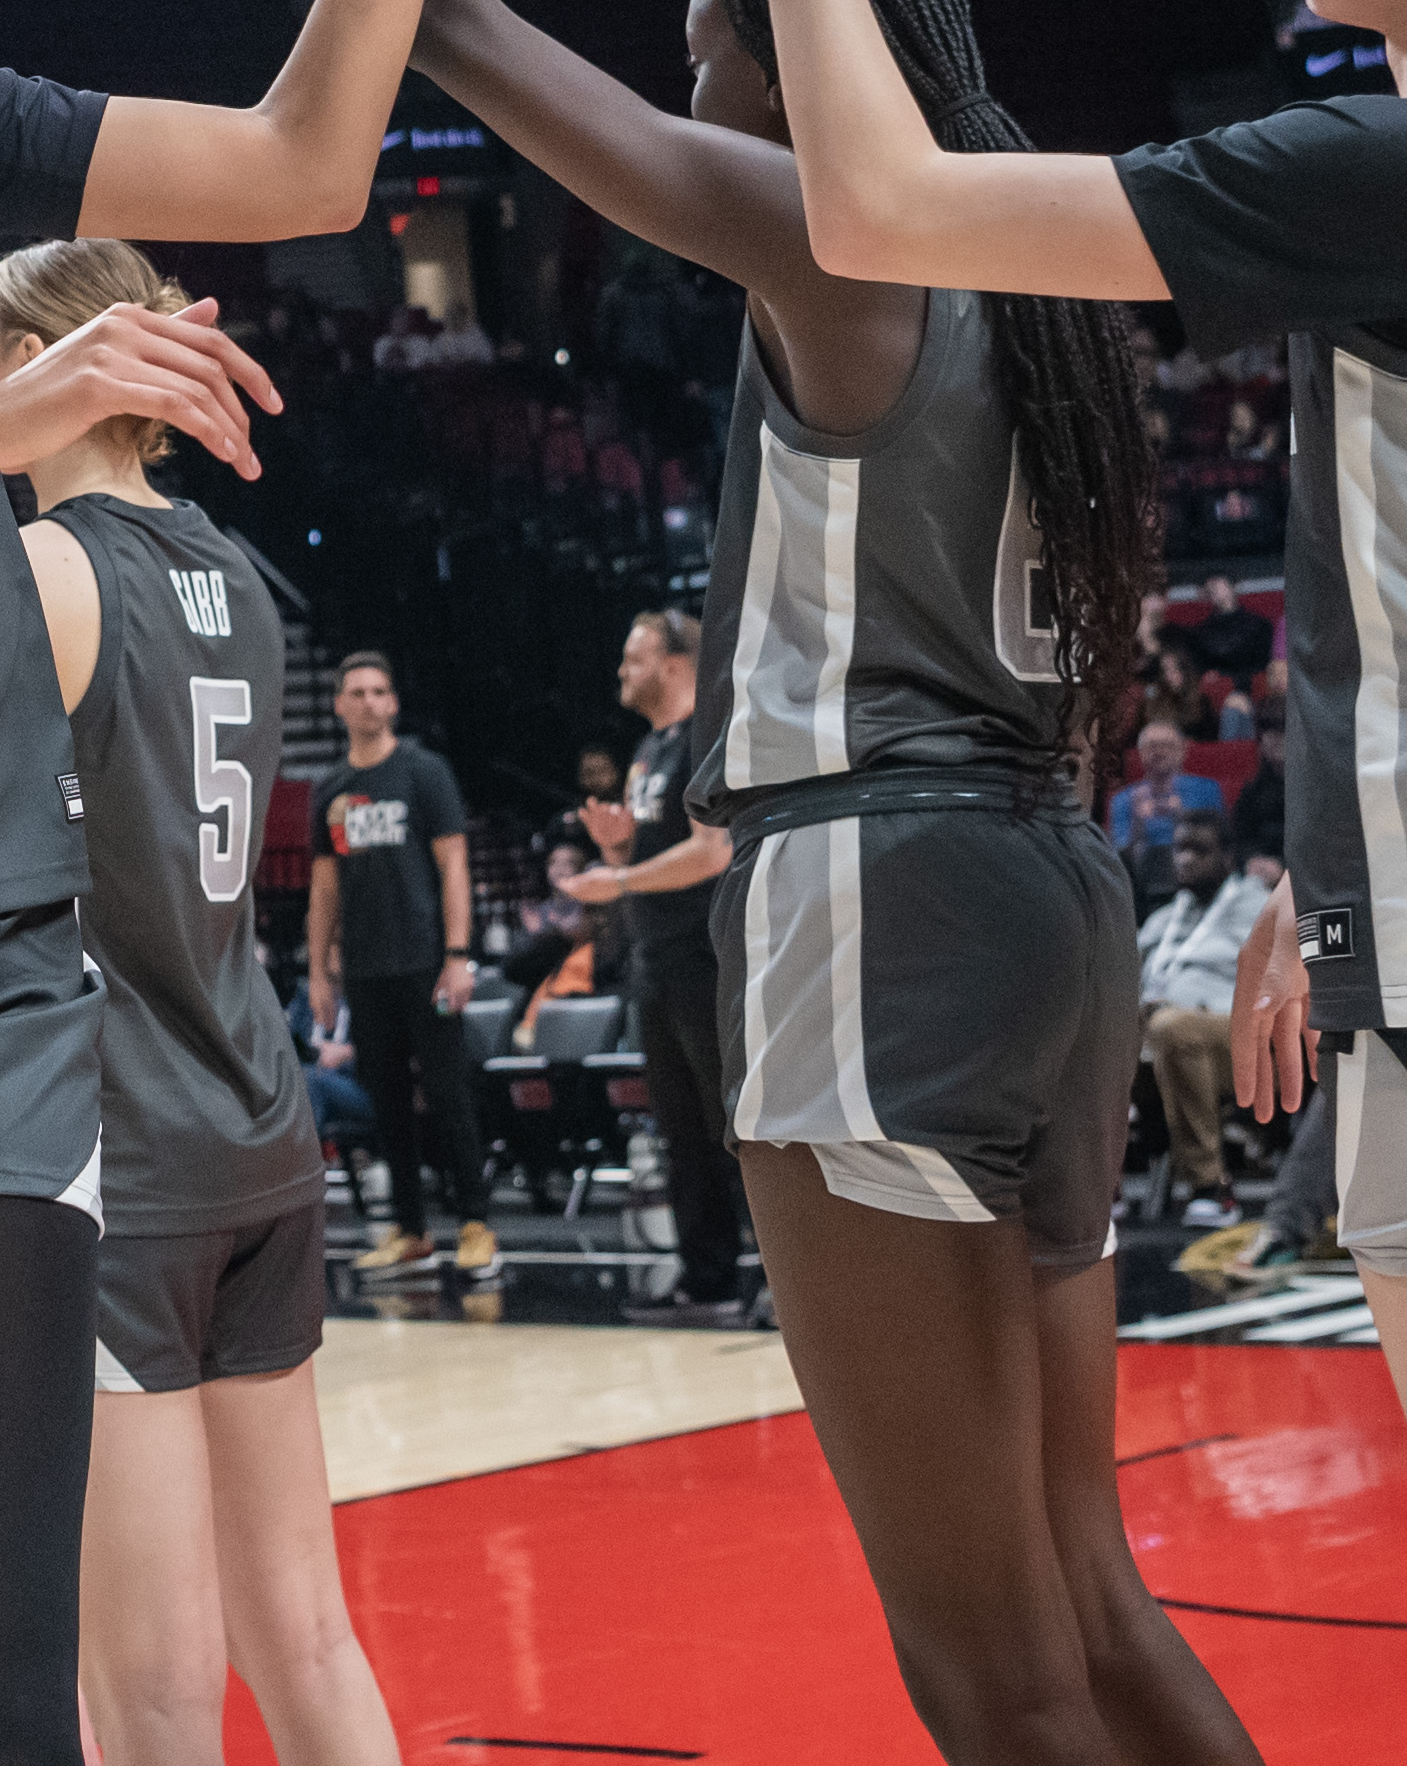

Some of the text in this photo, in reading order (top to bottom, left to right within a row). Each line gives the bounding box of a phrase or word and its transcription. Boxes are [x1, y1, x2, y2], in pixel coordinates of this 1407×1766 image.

[169, 568, 232, 637] GIBB
[189, 675, 252, 902] 5
[1326, 923, 1342, 945] M
